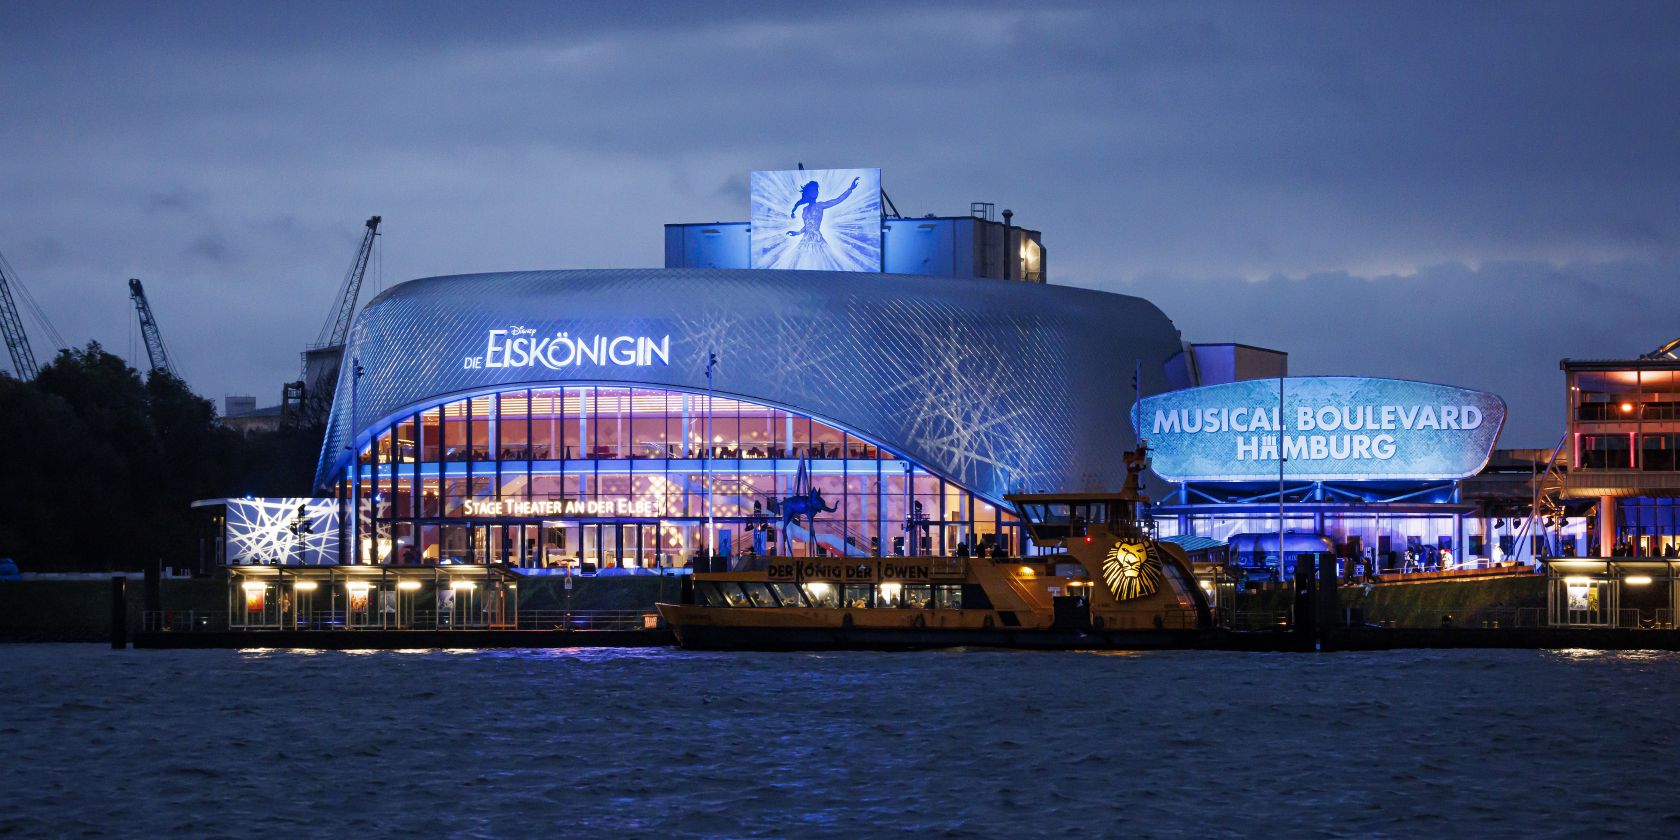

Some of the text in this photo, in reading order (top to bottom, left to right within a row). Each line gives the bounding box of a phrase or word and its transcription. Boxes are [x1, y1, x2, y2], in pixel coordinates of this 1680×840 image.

[509, 325, 537, 337] Disney
[464, 329, 670, 370] DIE EISKÖNIGIN
[1153, 404, 1484, 434] MUSICAL BOULEVARD
[1236, 434, 1397, 462] HAMBURG
[464, 497, 651, 515] STAGE THEATER AN DER ELBE
[768, 560, 929, 582] DER KÖNIG DER LÖWEN
